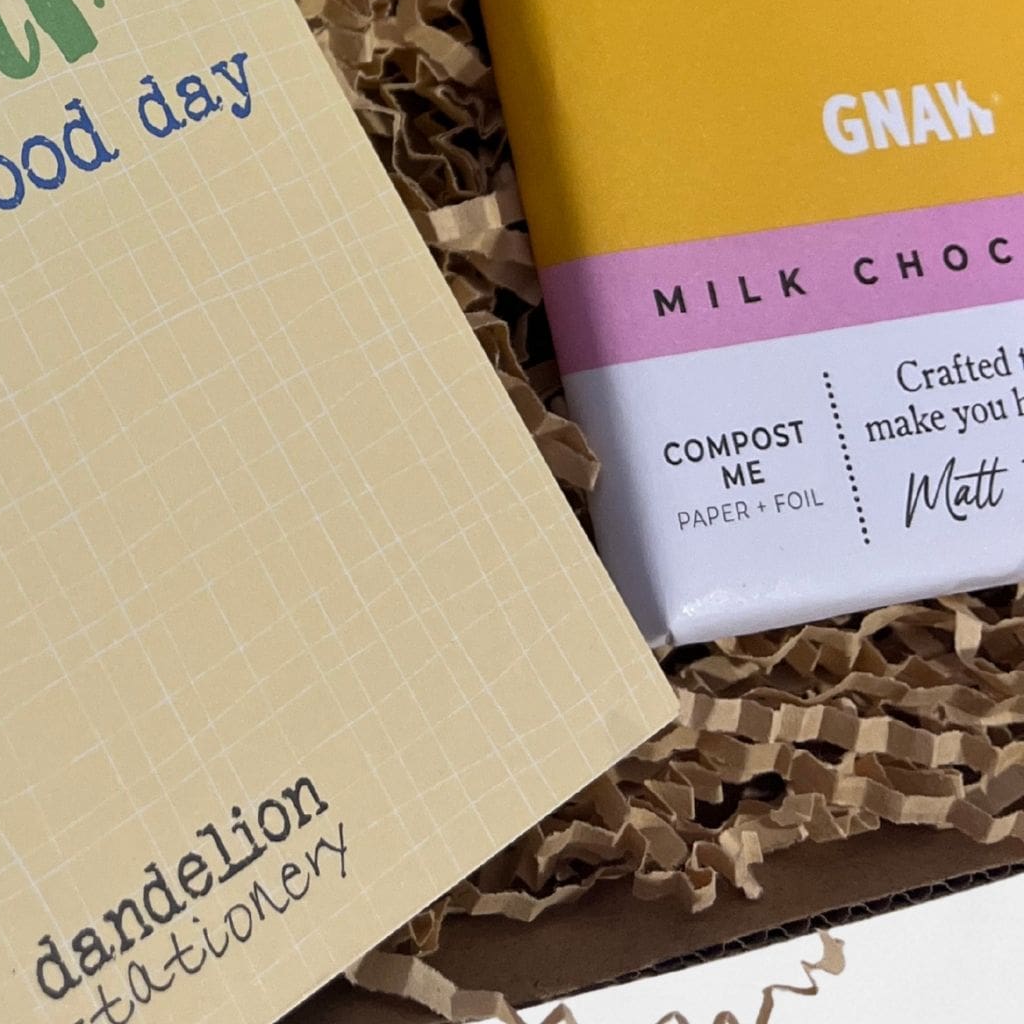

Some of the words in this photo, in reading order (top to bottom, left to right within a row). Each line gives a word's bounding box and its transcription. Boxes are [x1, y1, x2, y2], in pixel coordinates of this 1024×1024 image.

[137, 51, 251, 138] day
[822, 79, 996, 156] GNAW
[652, 266, 808, 318] MILK
[896, 345, 1013, 393] Crafted
[662, 419, 806, 466] COMPOST
[864, 403, 947, 443] make
[951, 397, 1009, 435] you
[721, 459, 766, 490] ME
[904, 455, 1009, 529] Matt
[676, 500, 751, 532] PAPER
[774, 487, 825, 513] FOIL
[36, 776, 330, 1000] dandelion
[72, 821, 348, 1024] tationery
